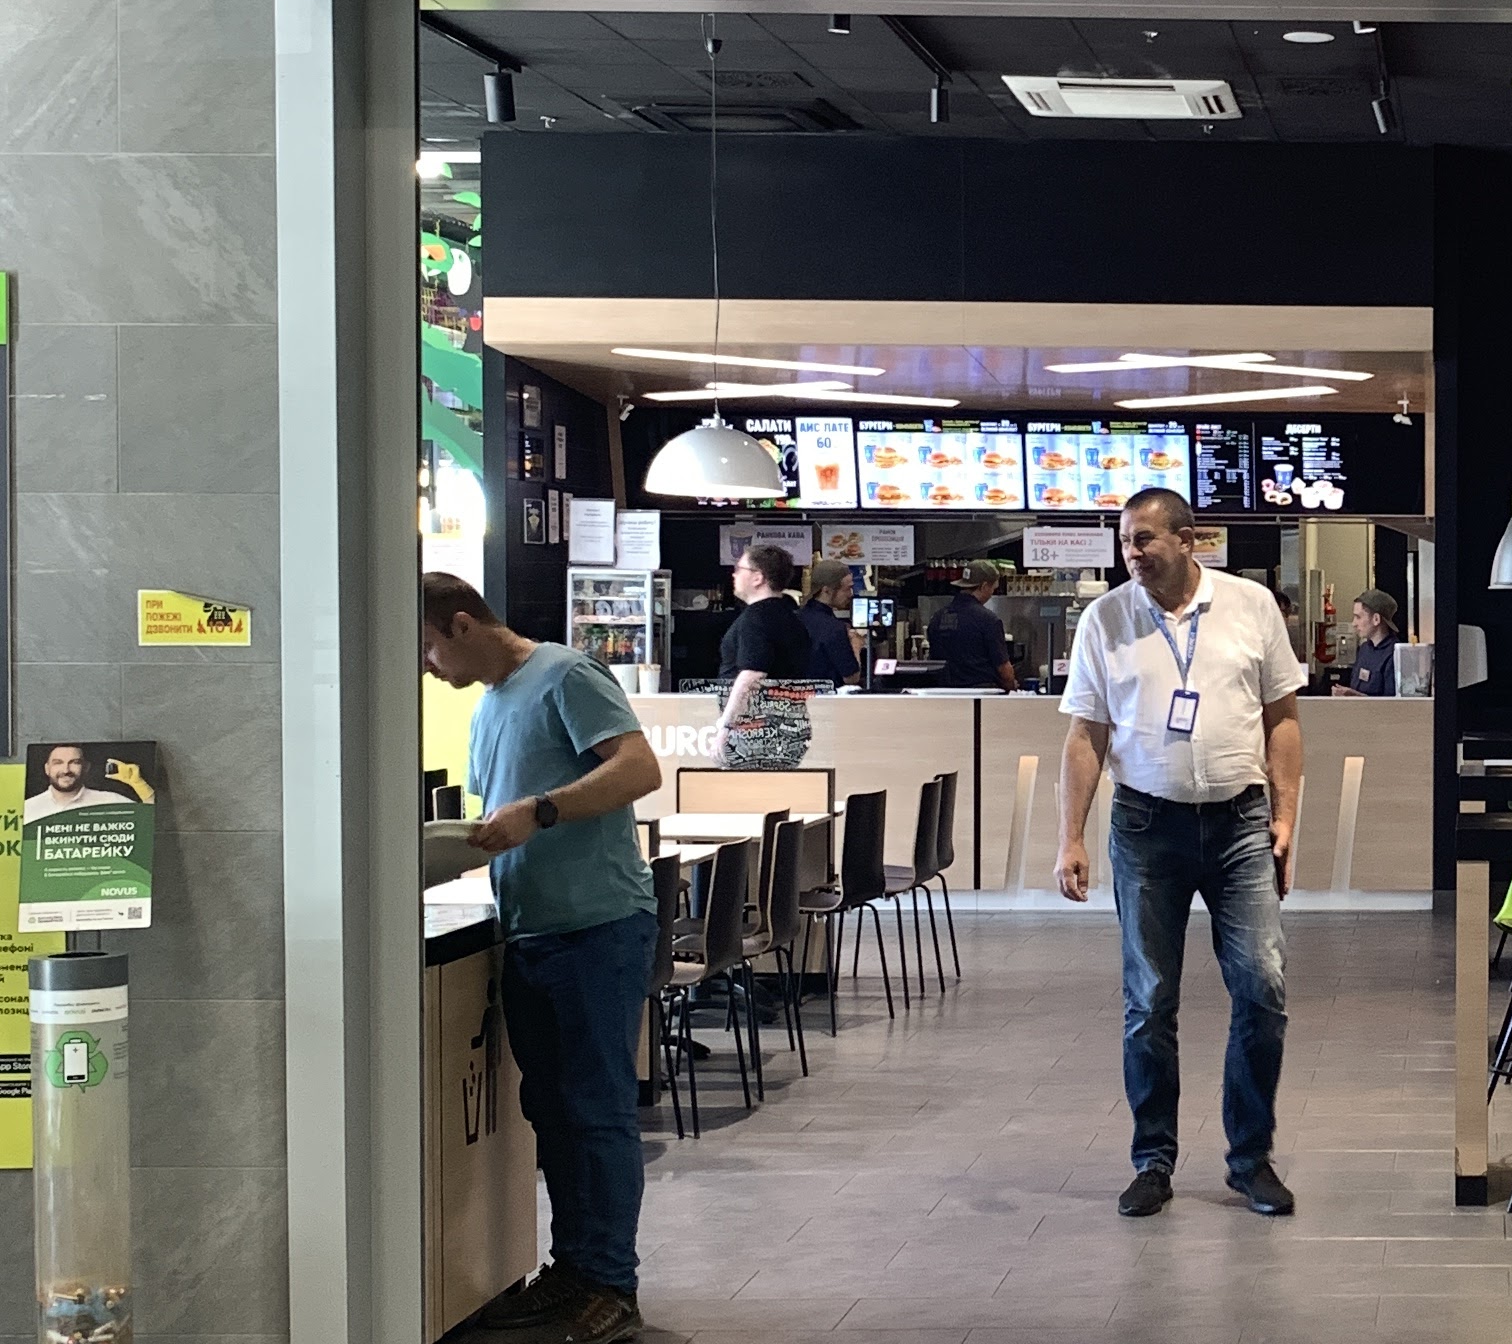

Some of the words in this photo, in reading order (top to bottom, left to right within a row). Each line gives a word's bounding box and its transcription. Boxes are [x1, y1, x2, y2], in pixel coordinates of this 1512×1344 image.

[816, 437, 832, 448] 60
[1031, 547, 1059, 562] 18+
[145, 599, 163, 609] ПРИ
[145, 612, 182, 622] ПОЖЕЖІ
[145, 624, 193, 635] ДЗВОНИТИ
[45, 824, 73, 834] МЕНІ
[75, 823, 91, 832] НЕ
[93, 821, 135, 832] ВАЖКО
[44, 835, 97, 845] ВКИНУТИ
[99, 833, 135, 844] СЮДИ
[44, 843, 134, 860] БАТАРЕЙКУ
[100, 886, 138, 897] NOVUS
